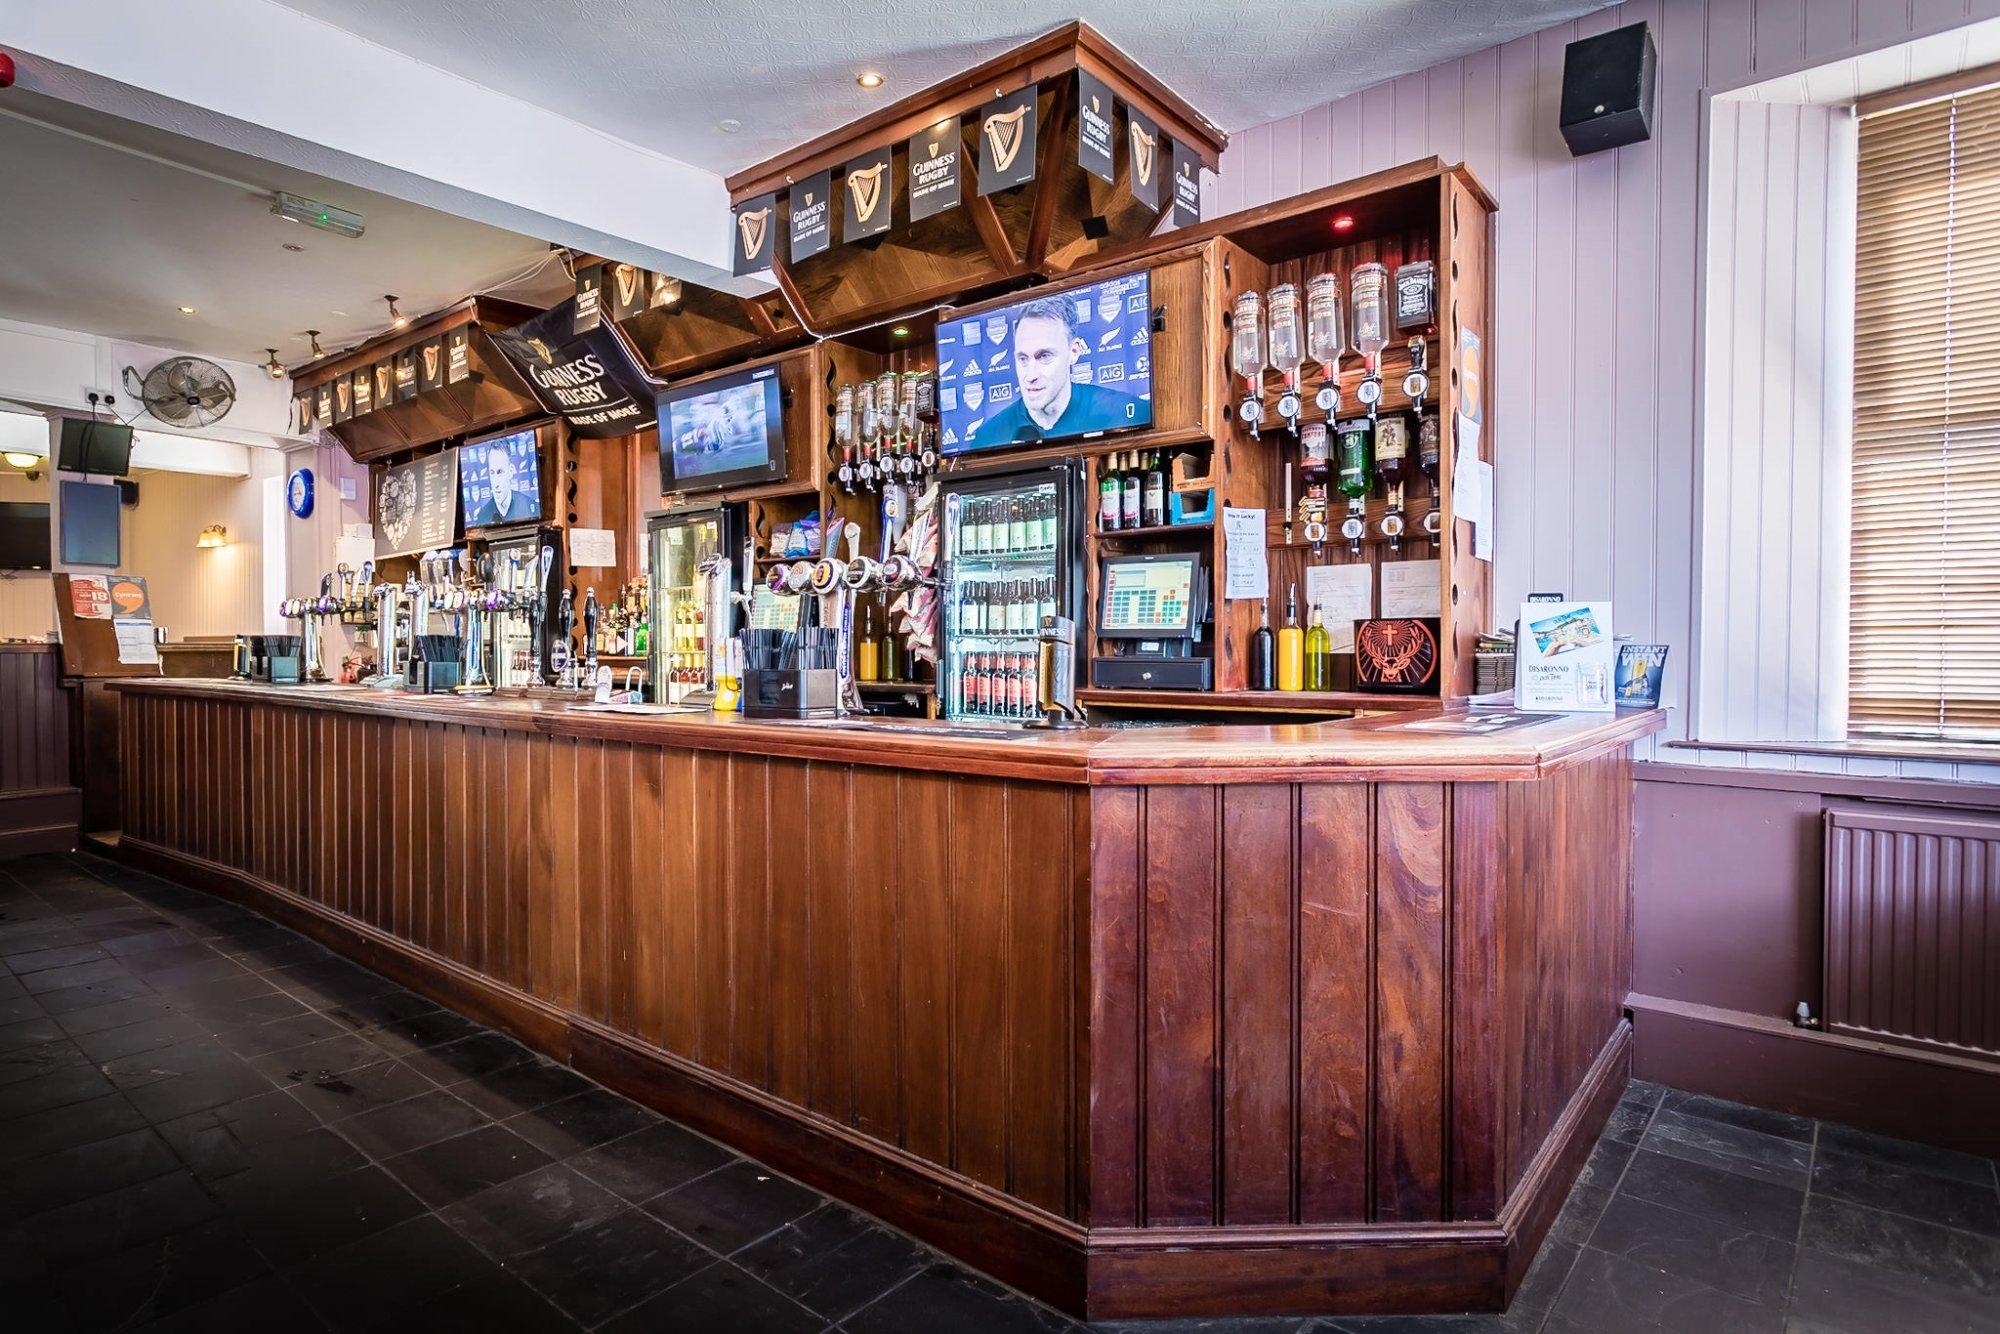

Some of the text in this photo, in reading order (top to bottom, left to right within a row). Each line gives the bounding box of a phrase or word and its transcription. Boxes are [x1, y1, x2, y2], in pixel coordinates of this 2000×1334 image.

[913, 152, 955, 177] GUINNESS
[919, 166, 949, 185] RUGBY
[793, 201, 826, 223] GUINNESS
[797, 213, 821, 231] RUGBY
[528, 354, 605, 389] GUINNESS
[1102, 366, 1122, 380] AIG
[553, 381, 608, 406] RUGBY
[992, 384, 1010, 399] AIG
[568, 403, 642, 426] MADE OF MORE
[92, 592, 108, 601] 18
[1528, 664, 1569, 673] DISARONNO
[1621, 652, 1666, 667] WIN
